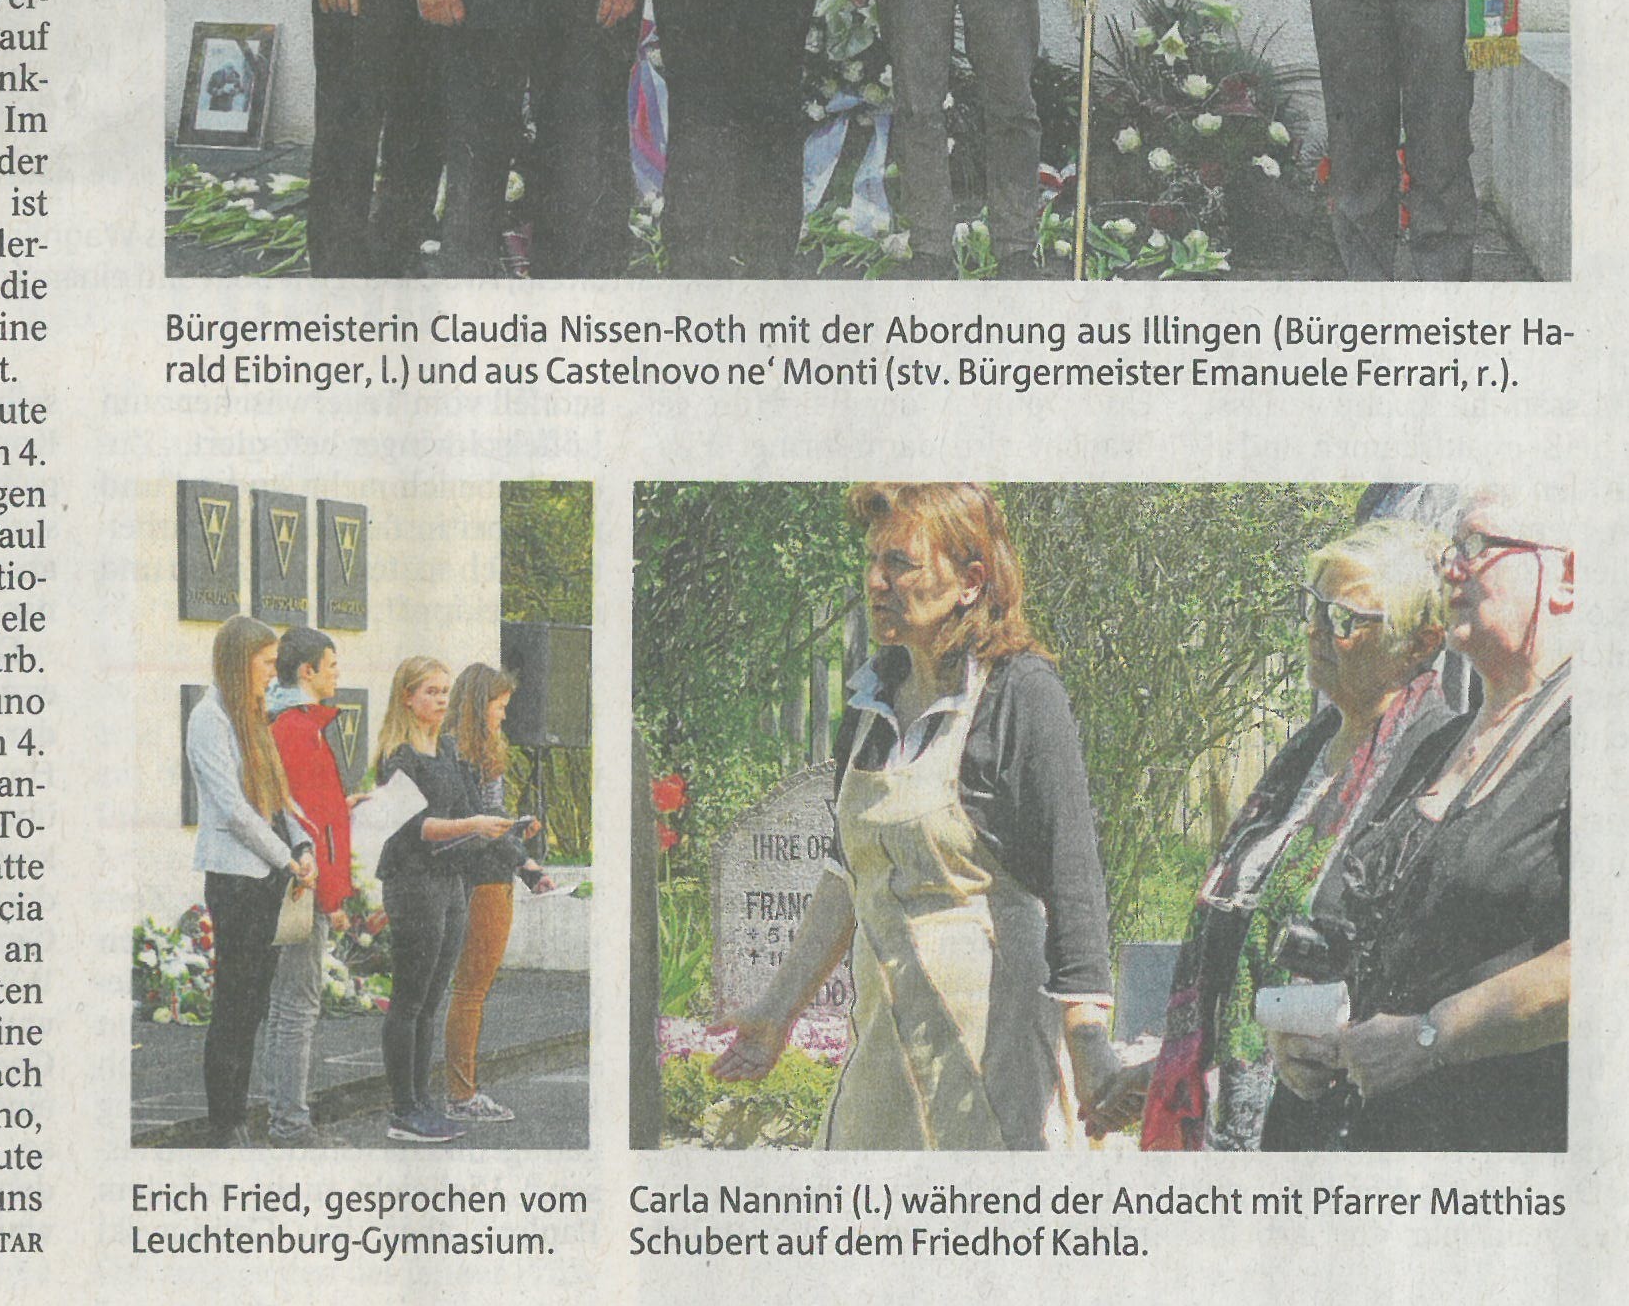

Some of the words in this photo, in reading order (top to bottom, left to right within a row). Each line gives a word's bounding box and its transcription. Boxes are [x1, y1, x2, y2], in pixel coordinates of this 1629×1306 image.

[166, 313, 418, 350] Bürgermeisterin
[430, 313, 547, 343] Claudia
[561, 313, 746, 344] Nissen-Roth
[759, 314, 811, 344] mit
[821, 314, 875, 344] der
[885, 314, 1066, 352] Abordnung
[1077, 322, 1131, 345] aus
[1143, 314, 1261, 353] Illingen
[1274, 314, 1512, 353] (Bürgermeister
[1523, 317, 1575, 346] Ha-
[166, 353, 225, 384] rald
[235, 353, 372, 391] Eibinger,
[381, 354, 410, 391] l.)
[418, 354, 477, 385] und
[485, 363, 539, 385] aus
[546, 355, 720, 385] Castelnovo
[783, 356, 877, 386] Monti
[885, 355, 950, 392] (stv.
[959, 357, 1185, 393] Bürgermeister
[1192, 357, 1348, 387] Emanuele
[1357, 358, 1468, 393] Ferrari,
[1477, 356, 1518, 394] r.).
[132, 1182, 207, 1212] Erich
[223, 1182, 310, 1218] Fried,
[324, 1183, 506, 1220] gesprochen
[519, 1191, 587, 1213] vom
[629, 1183, 709, 1214] Carla
[720, 1184, 843, 1214] Nannini
[852, 1183, 892, 1221] (l.)
[901, 1184, 1041, 1215] während
[1051, 1184, 1104, 1215] der
[1112, 1185, 1243, 1215] Andacht
[1252, 1186, 1303, 1215] mit
[1313, 1184, 1422, 1216] Pfarrer
[1430, 1185, 1566, 1216] Matthias
[132, 1224, 554, 1262] Leuchtenburg-Gymnasium.
[629, 1225, 769, 1256] Schubert
[776, 1225, 829, 1256] auf
[834, 1225, 903, 1256] dem
[912, 1226, 1046, 1257] Friedhof
[1052, 1226, 1148, 1257] Kahla.
